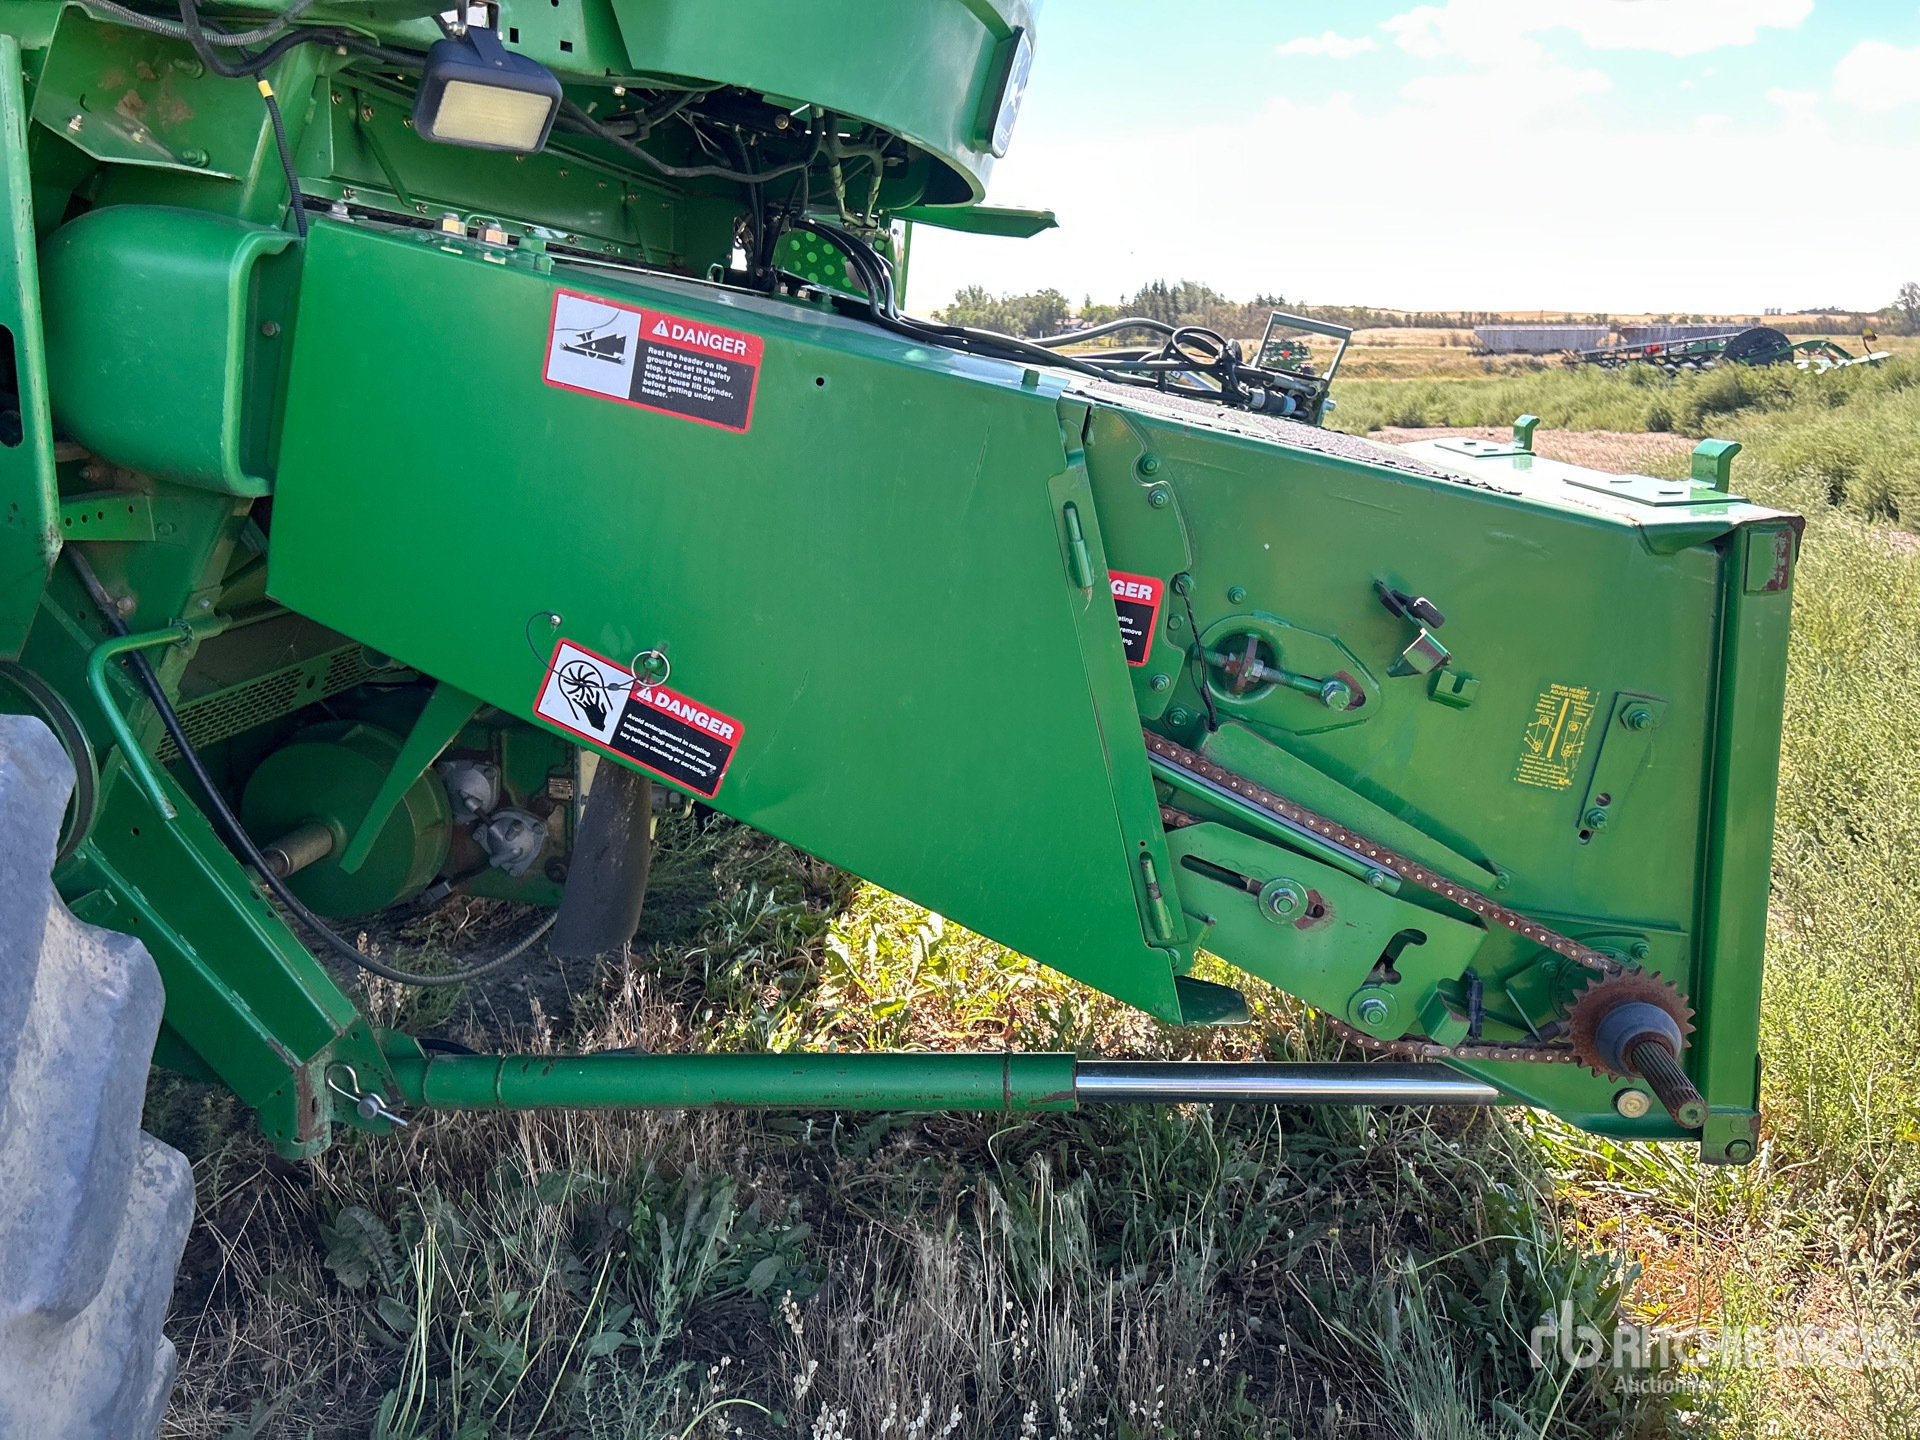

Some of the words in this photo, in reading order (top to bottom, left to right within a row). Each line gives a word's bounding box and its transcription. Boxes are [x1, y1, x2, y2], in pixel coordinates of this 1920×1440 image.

[672, 324, 746, 356] DANGER
[647, 355, 672, 367] ground
[683, 364, 694, 372] set
[696, 366, 708, 376] the
[709, 371, 730, 382] safety
[648, 346, 665, 357] Rest
[666, 350, 677, 359] the
[679, 353, 703, 366] header
[705, 361, 714, 369] on
[716, 363, 727, 372] the
[644, 370, 667, 382] feeder
[668, 377, 690, 387] house
[691, 382, 702, 390] lift
[703, 385, 733, 399] cylinder,
[646, 364, 663, 374] stop,
[665, 367, 691, 379] located
[704, 376, 715, 385] the
[641, 386, 668, 398] header.
[643, 379, 666, 390] before
[667, 385, 692, 397] getting
[694, 391, 714, 401] under
[1110, 579, 1152, 600] GER
[1117, 616, 1133, 624] ating
[1120, 627, 1142, 635] remove
[1550, 689, 1588, 701] ADJUSTMENT
[1551, 683, 1568, 692] DRUM
[1569, 687, 1590, 696] HEIGHT
[654, 691, 734, 740] DANGER
[627, 713, 645, 725] Avoid
[644, 722, 682, 743] entanglement
[688, 742, 711, 757] rotating
[620, 731, 631, 740] key
[631, 736, 649, 749] before
[649, 745, 673, 761] cleaning
[681, 760, 707, 777] servicing.
[651, 735, 665, 746] Stop
[665, 742, 685, 755] engine
[685, 751, 696, 760] and
[696, 757, 717, 770] remove
